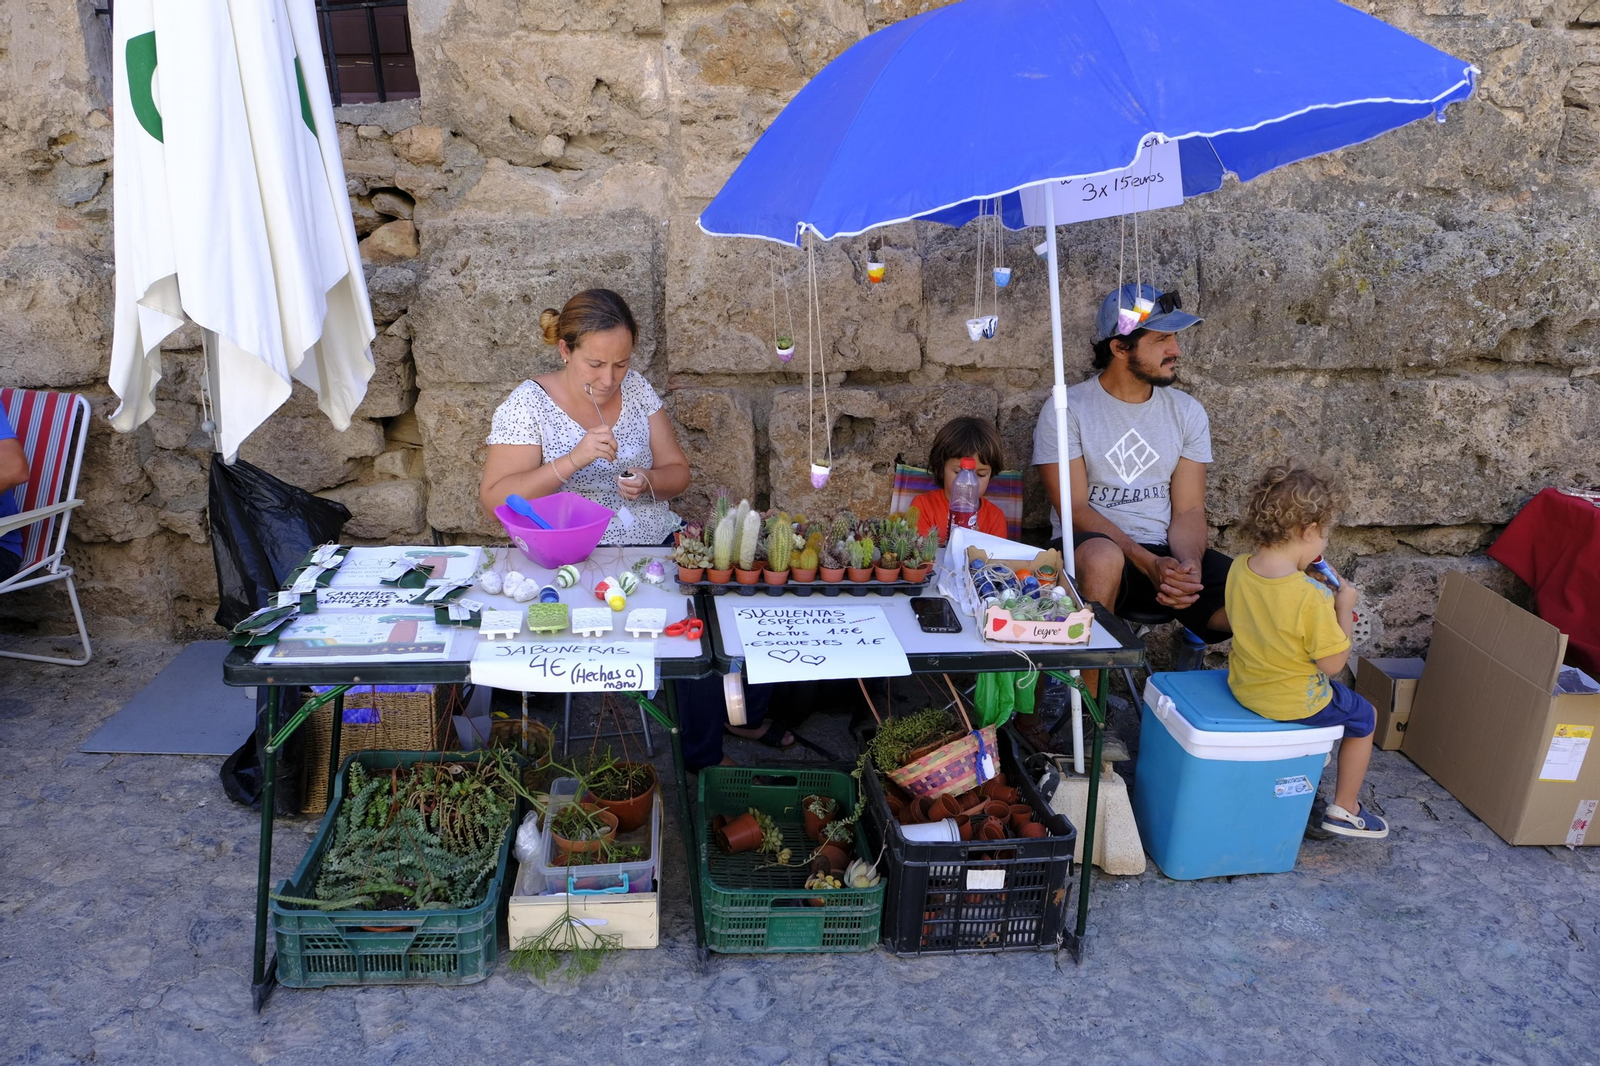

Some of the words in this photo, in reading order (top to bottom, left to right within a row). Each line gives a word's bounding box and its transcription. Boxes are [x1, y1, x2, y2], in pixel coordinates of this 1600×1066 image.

[1082, 182, 1108, 201] 3x
[750, 639, 843, 647] ESQUEJES
[495, 645, 631, 657] JABONERAS
[528, 655, 567, 678] 4€
